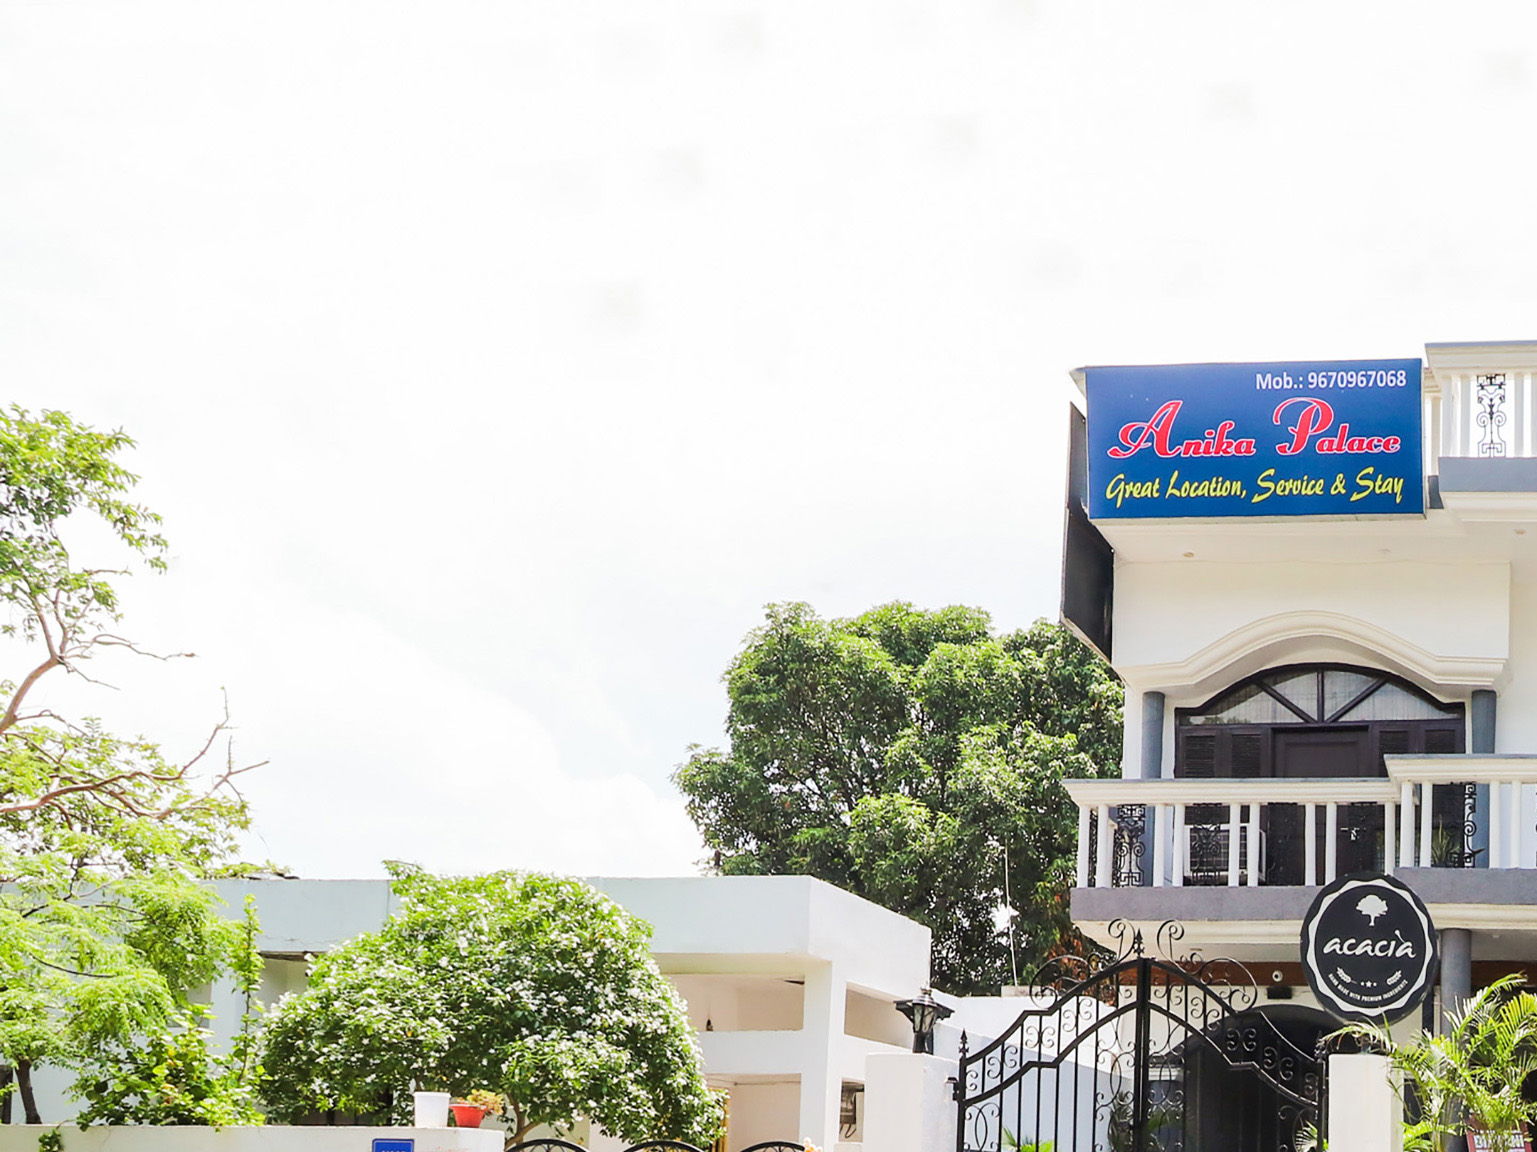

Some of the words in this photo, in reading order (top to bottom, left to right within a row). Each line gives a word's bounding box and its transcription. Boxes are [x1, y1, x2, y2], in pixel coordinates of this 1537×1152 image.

[1256, 373, 1303, 390] Mob.:
[1308, 370, 1407, 389] 9670967068
[1107, 400, 1257, 459] Anika
[1273, 397, 1401, 457] Palace
[1106, 473, 1159, 508] Great
[1165, 470, 1246, 499] Location,
[1251, 468, 1325, 503] Service
[1330, 473, 1346, 494] &
[1350, 466, 1404, 504] Stay
